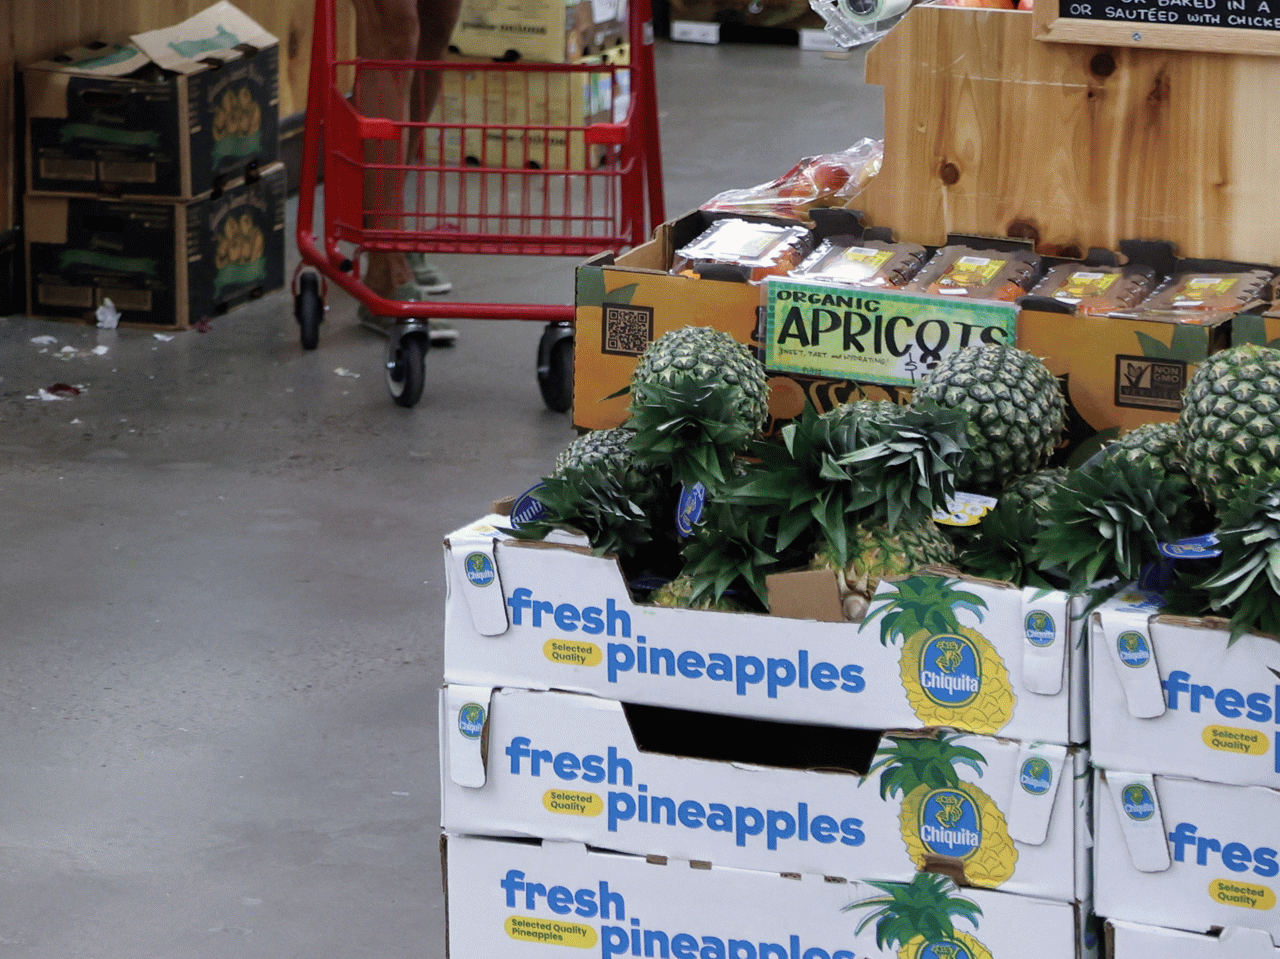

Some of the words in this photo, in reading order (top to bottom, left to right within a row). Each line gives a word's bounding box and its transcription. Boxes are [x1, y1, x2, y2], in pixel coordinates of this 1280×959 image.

[1070, 3, 1092, 16] OR
[1258, 1, 1271, 13] A
[776, 289, 881, 313] ORGANIC
[507, 587, 632, 639] fresh
[551, 642, 592, 655] Selected
[551, 651, 586, 663] Quality
[607, 635, 866, 699] pineapples
[920, 670, 980, 695] Chiquita
[1161, 670, 1280, 725] fres
[1211, 729, 1259, 743] Selected
[1211, 738, 1251, 753] Quality
[505, 736, 633, 787] fresh
[550, 791, 592, 804] Selected
[550, 801, 586, 813] Quality
[607, 784, 866, 851] pineapples
[920, 824, 980, 849] Chiquita
[500, 869, 625, 921] fresh
[1217, 882, 1265, 897] Selected
[1217, 891, 1257, 908] Quality
[511, 918, 552, 932] Selected
[553, 923, 588, 937] Quality
[511, 927, 564, 942] Pineapples
